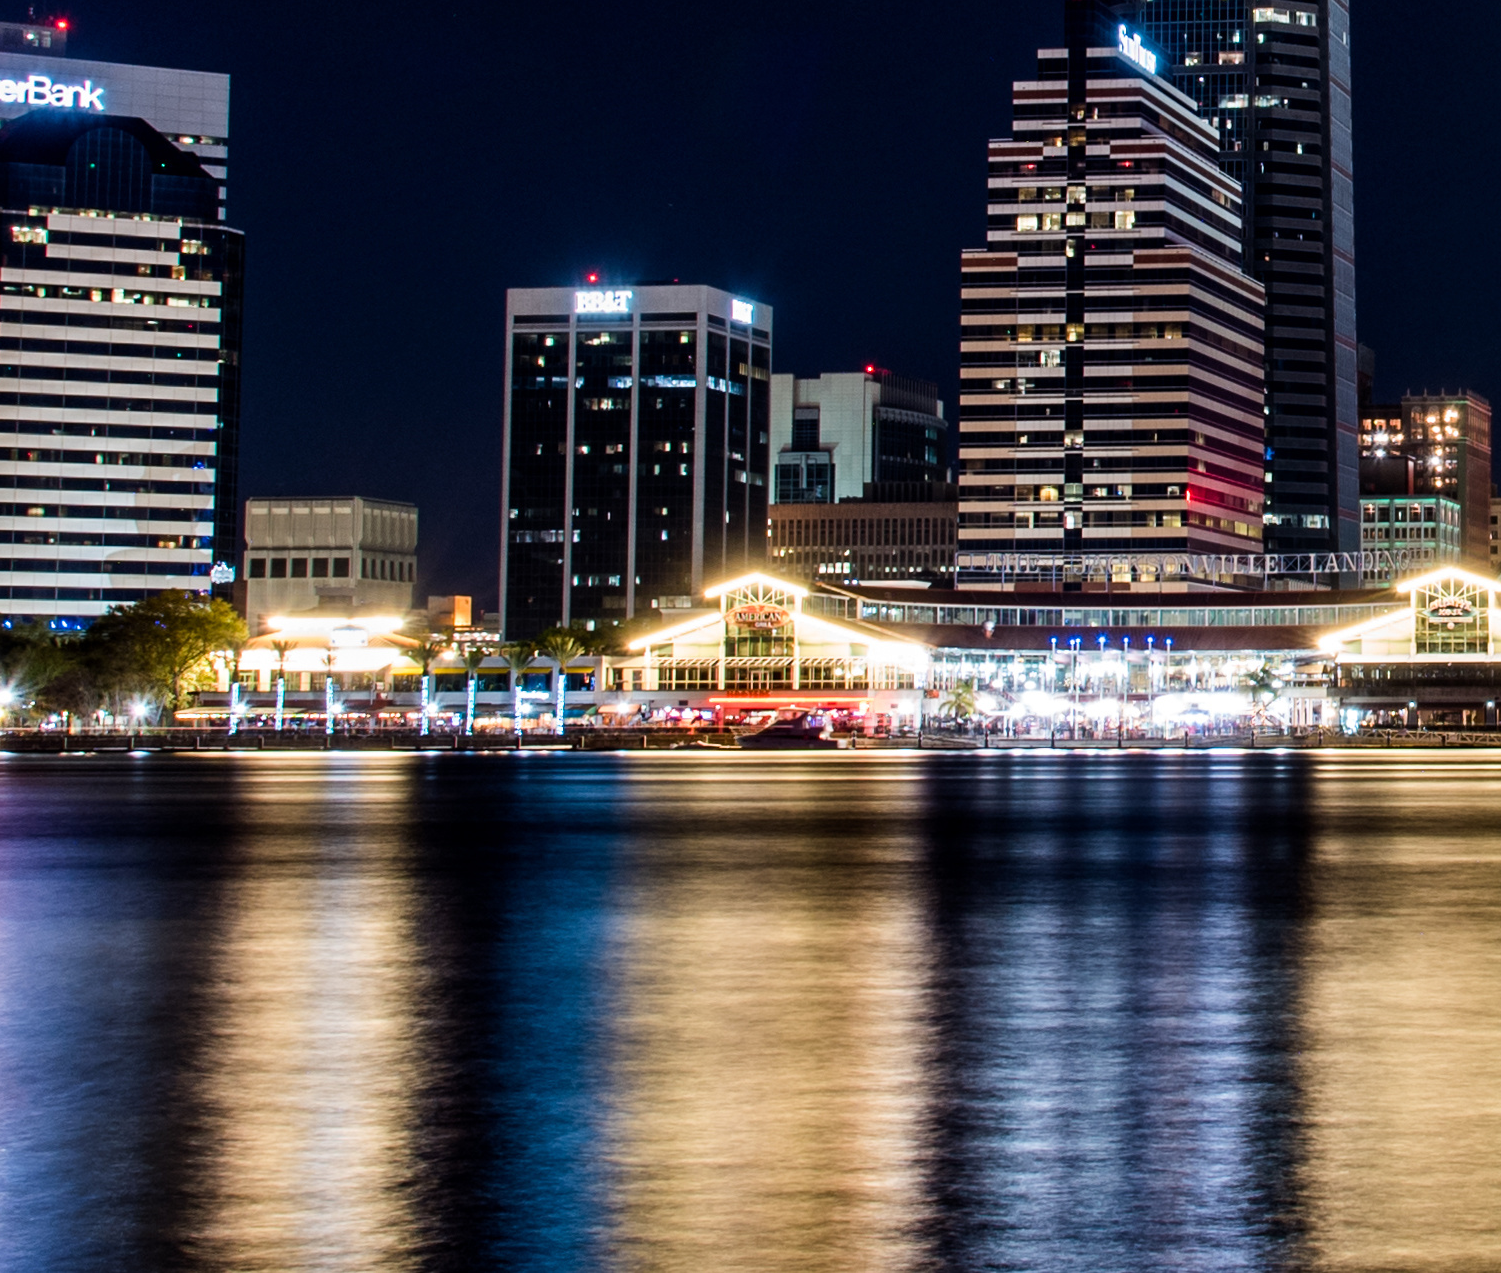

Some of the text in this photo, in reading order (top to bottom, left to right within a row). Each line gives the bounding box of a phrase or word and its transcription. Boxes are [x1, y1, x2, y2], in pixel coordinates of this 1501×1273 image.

[574, 290, 633, 313] BB&T
[987, 549, 1410, 575] THE JACKSONVILLE LANDING
[735, 612, 782, 622] AMERICAN
